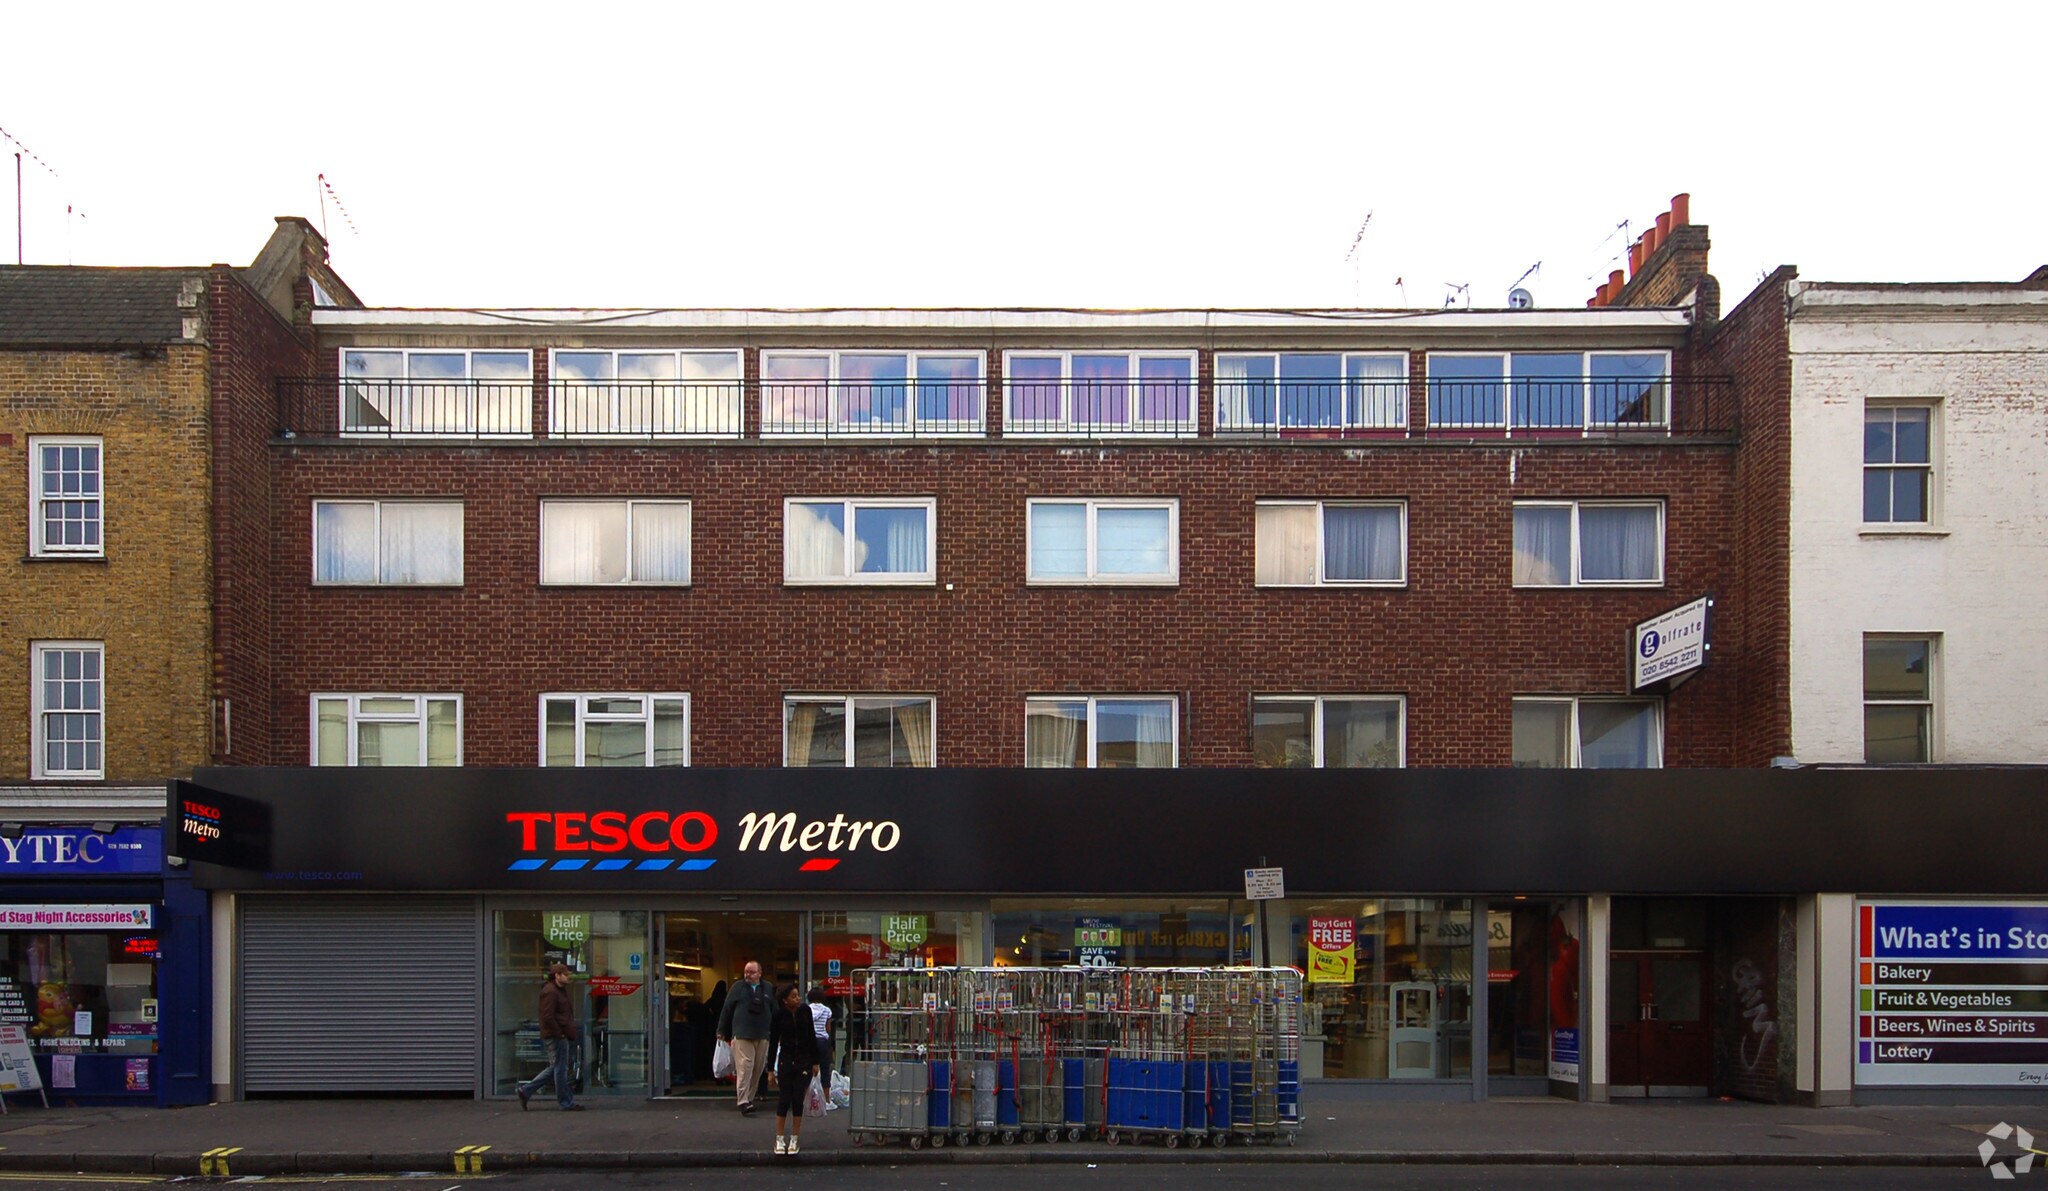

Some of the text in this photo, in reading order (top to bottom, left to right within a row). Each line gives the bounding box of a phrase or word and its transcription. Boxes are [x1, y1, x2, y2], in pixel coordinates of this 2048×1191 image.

[1642, 664, 1657, 677] 020
[1680, 649, 1697, 662] 2211
[183, 800, 221, 820] TESCO
[183, 819, 220, 839] Metro
[506, 811, 900, 853] TESCO Metro
[264, 871, 363, 881] www.tesco.com
[9, 911, 33, 924] Stag
[35, 911, 63, 924] Night
[66, 911, 132, 923] Accessories
[552, 915, 581, 928] Half
[889, 916, 919, 930] Half
[1312, 920, 1328, 928] Buy
[1333, 920, 1347, 928] Get
[549, 928, 584, 941] Price
[887, 930, 921, 943] Price
[1312, 929, 1352, 943] FREE
[1977, 928, 2001, 949] in
[1081, 947, 1103, 955] SAVE
[1879, 965, 1931, 982] Bakery
[1879, 992, 2012, 1009] Fruit & Vegetables
[1879, 1018, 2036, 1035] Beers, Wines & Spirits
[102, 1038, 126, 1047] REPAIRS
[1879, 1044, 1933, 1061] Lottery
